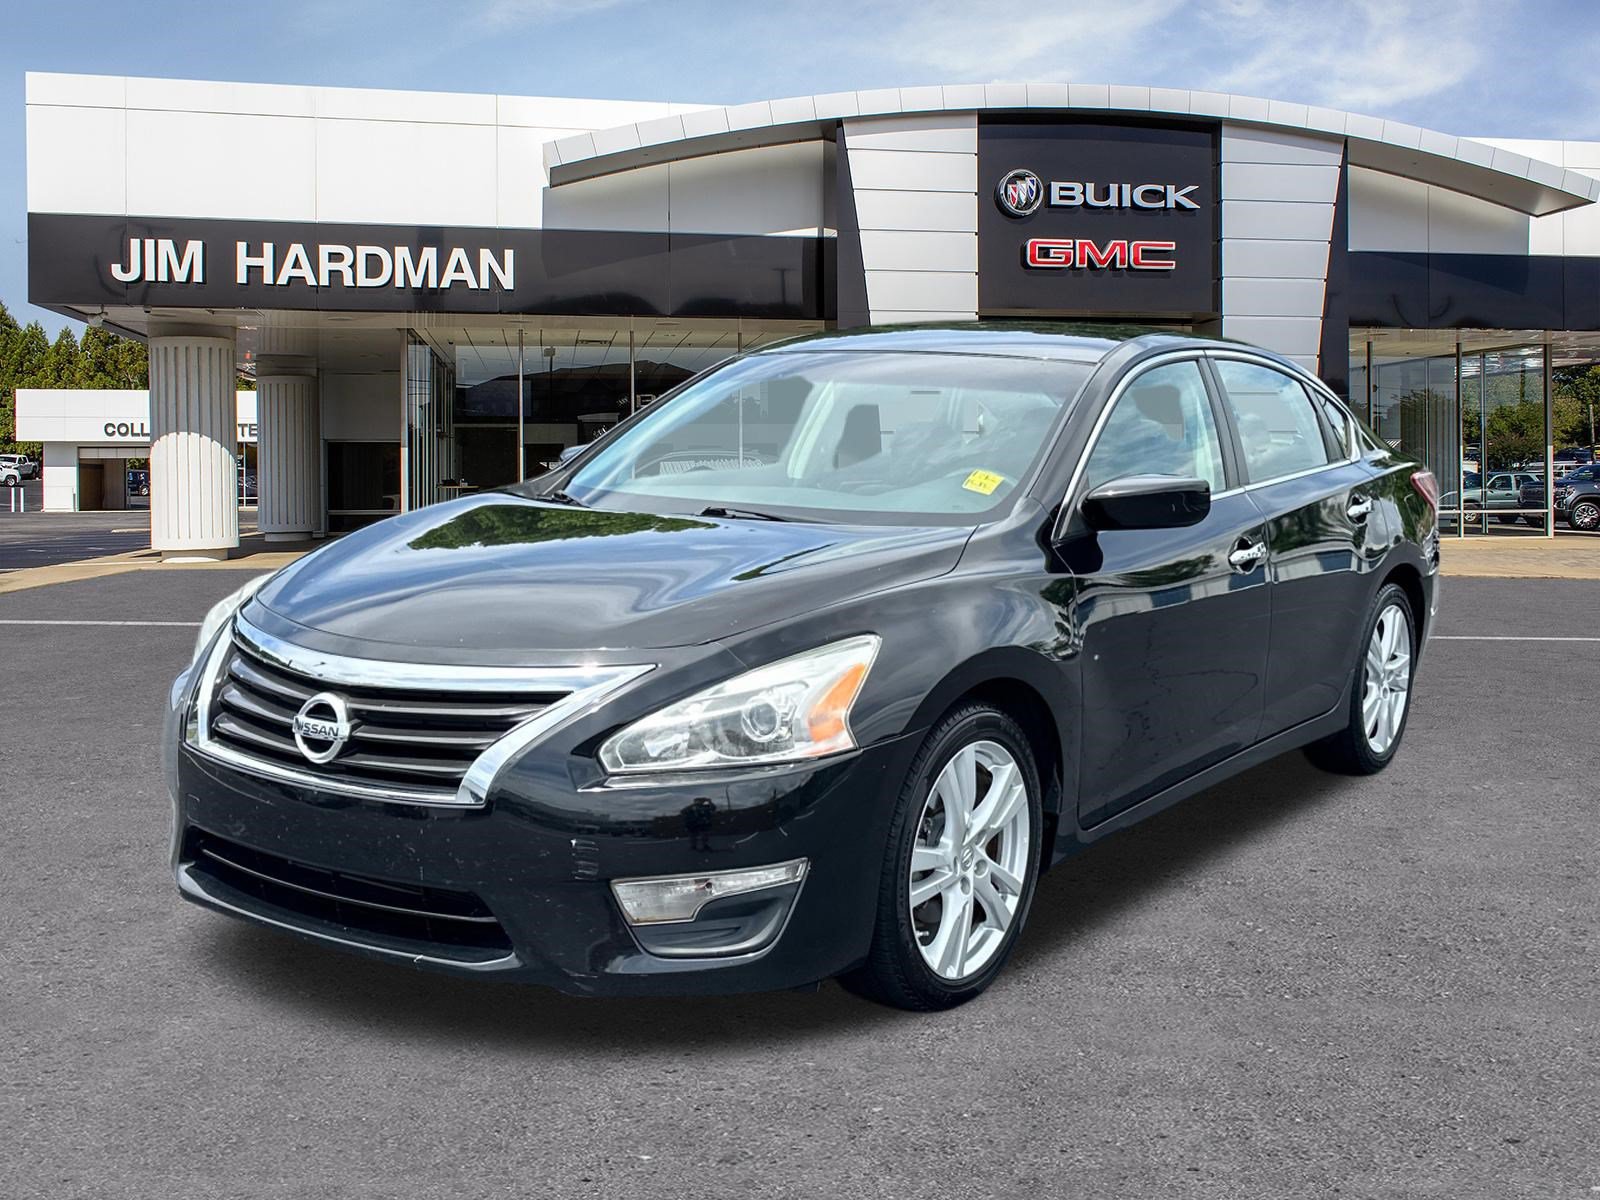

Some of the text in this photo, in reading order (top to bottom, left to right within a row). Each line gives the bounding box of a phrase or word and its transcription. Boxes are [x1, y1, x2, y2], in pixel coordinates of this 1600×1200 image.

[1051, 181, 1200, 209] BUICK
[111, 238, 515, 290] JIM HARDMAN
[1026, 238, 1176, 270] GMC
[295, 717, 339, 737] NISSAN
